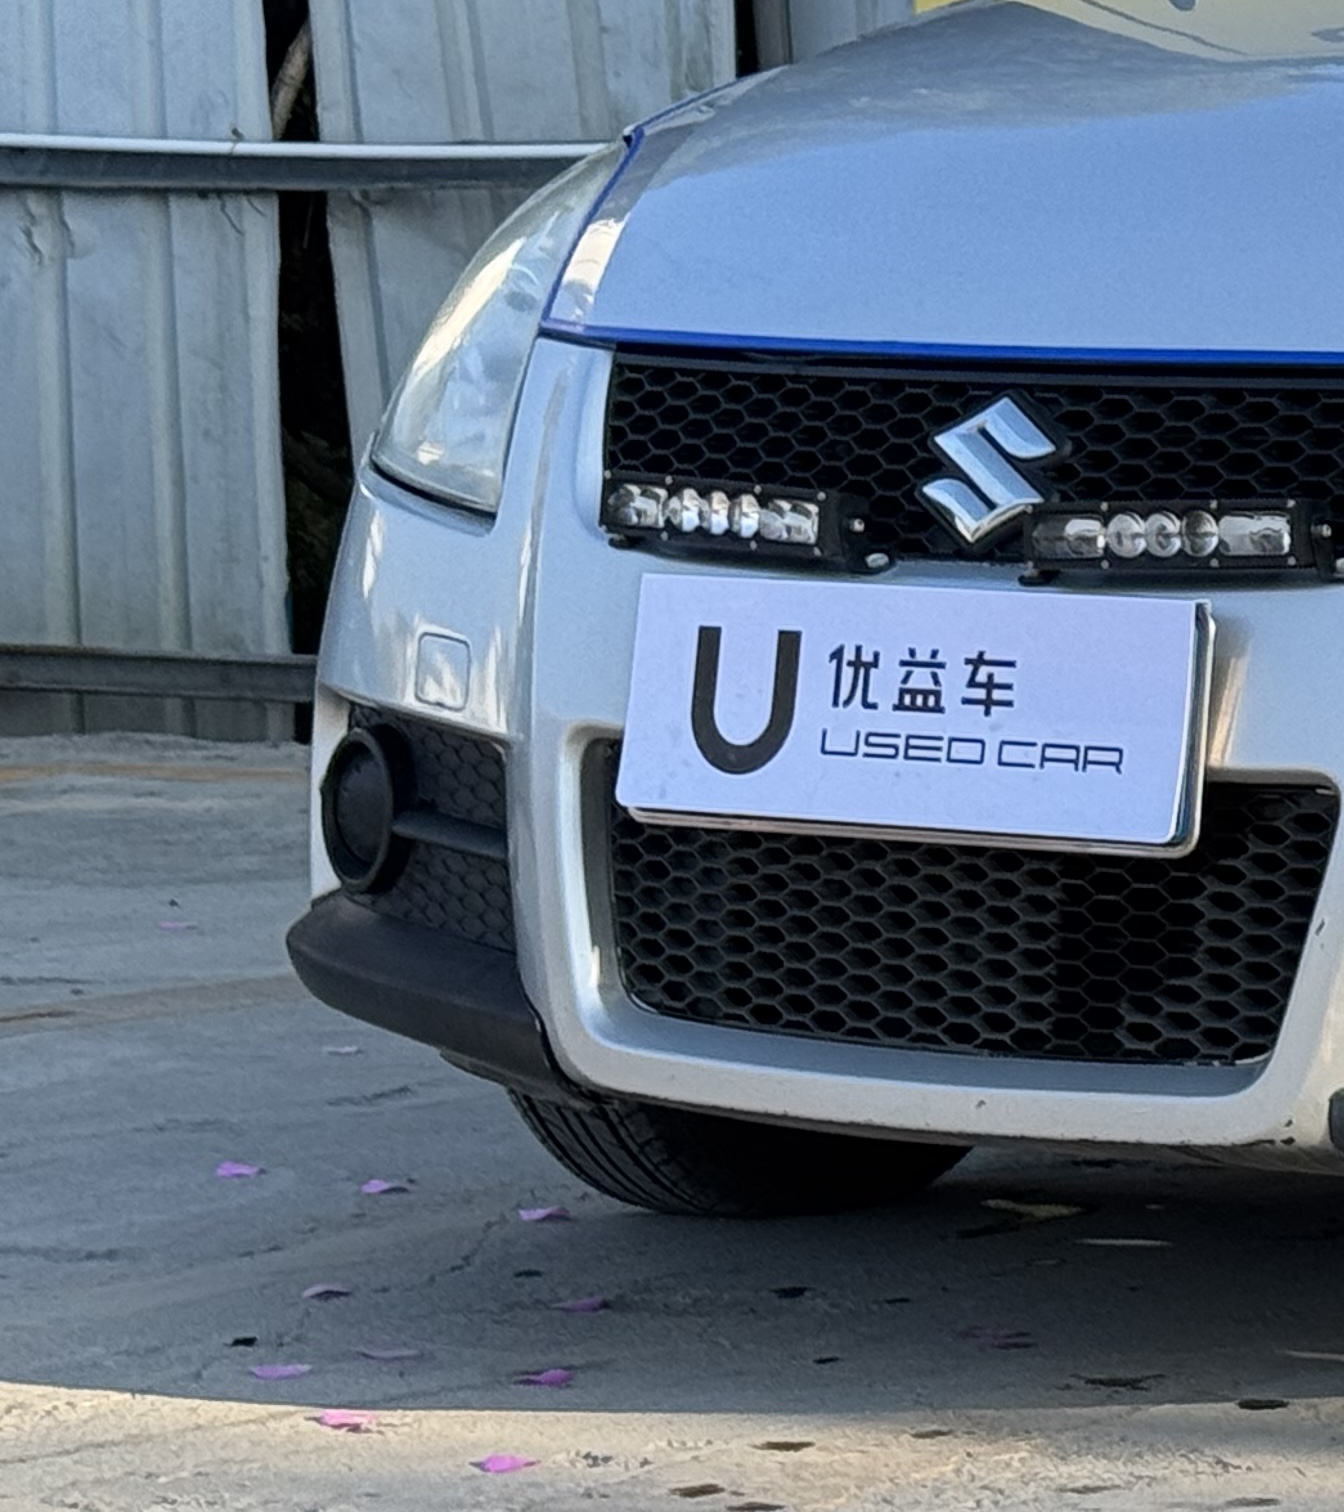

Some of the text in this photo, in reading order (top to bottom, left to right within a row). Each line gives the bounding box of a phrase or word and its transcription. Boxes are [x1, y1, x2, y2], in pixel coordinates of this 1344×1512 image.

[828, 644, 1017, 718] 优益车
[820, 728, 1124, 775] USED CAR
